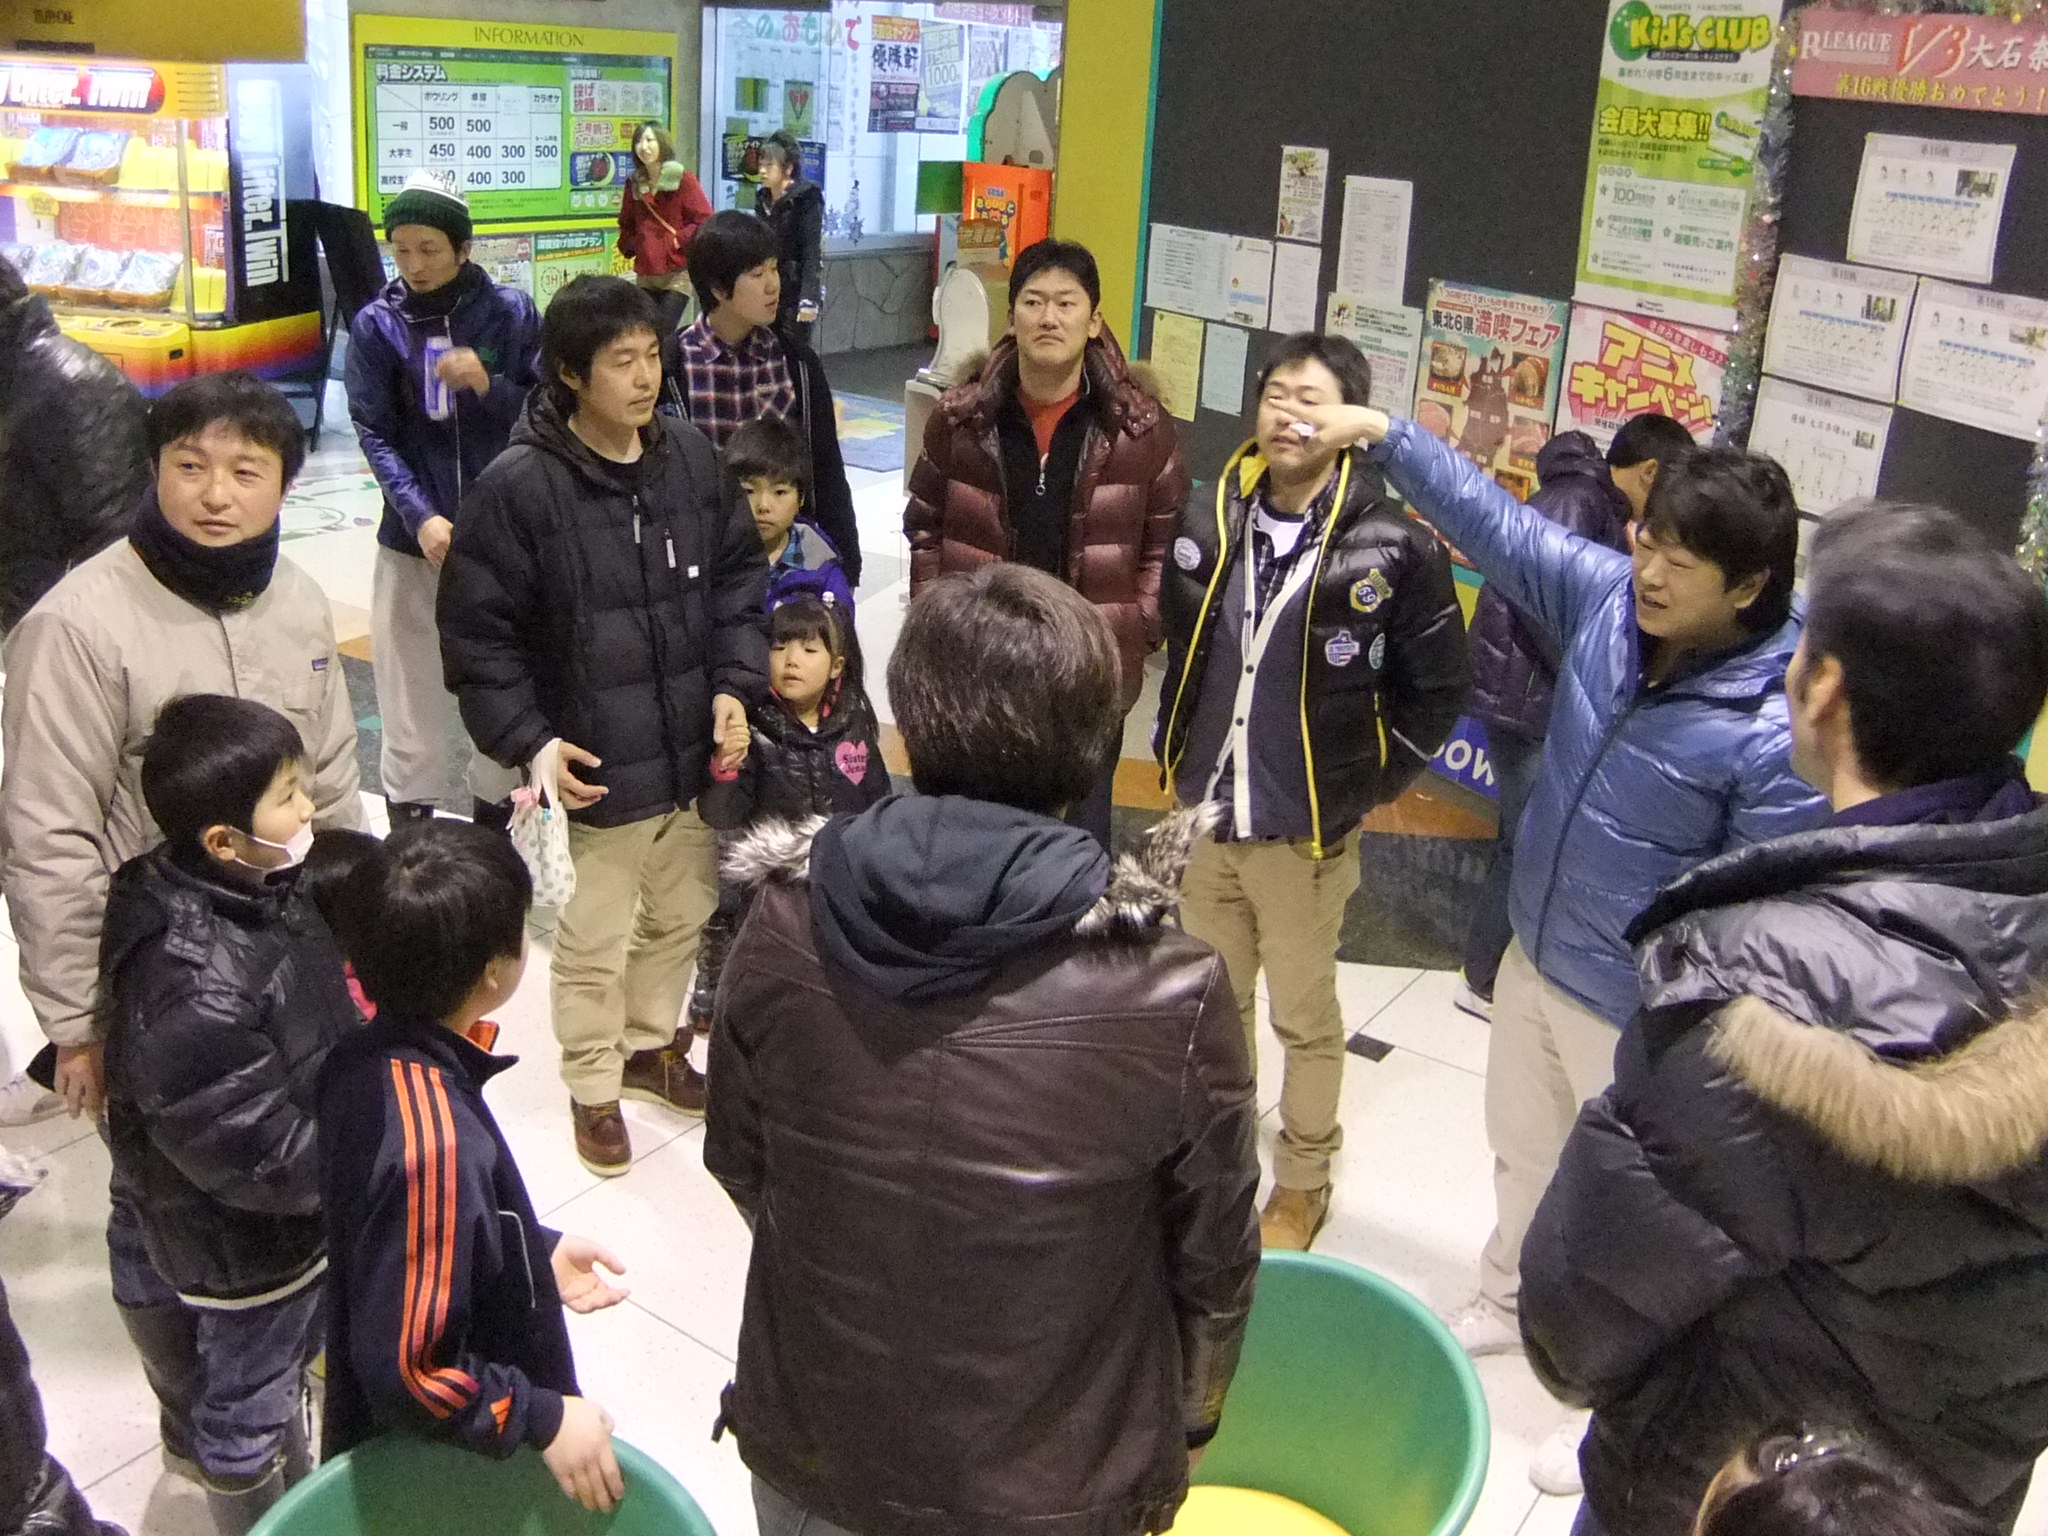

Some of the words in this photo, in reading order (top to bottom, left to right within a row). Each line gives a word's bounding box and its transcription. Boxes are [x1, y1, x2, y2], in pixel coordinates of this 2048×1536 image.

[474, 25, 585, 47] INFORMATION
[1629, 15, 1695, 50] Kid's
[1696, 15, 1772, 52] CLUB
[429, 116, 455, 131] 500
[466, 118, 491, 133] 500
[429, 143, 455, 158] 450
[466, 144, 491, 159] 400
[501, 144, 526, 159] 300
[534, 144, 558, 159] 500
[466, 171, 491, 186] 400
[501, 171, 526, 186] 300
[1602, 320, 1697, 390] アニメ
